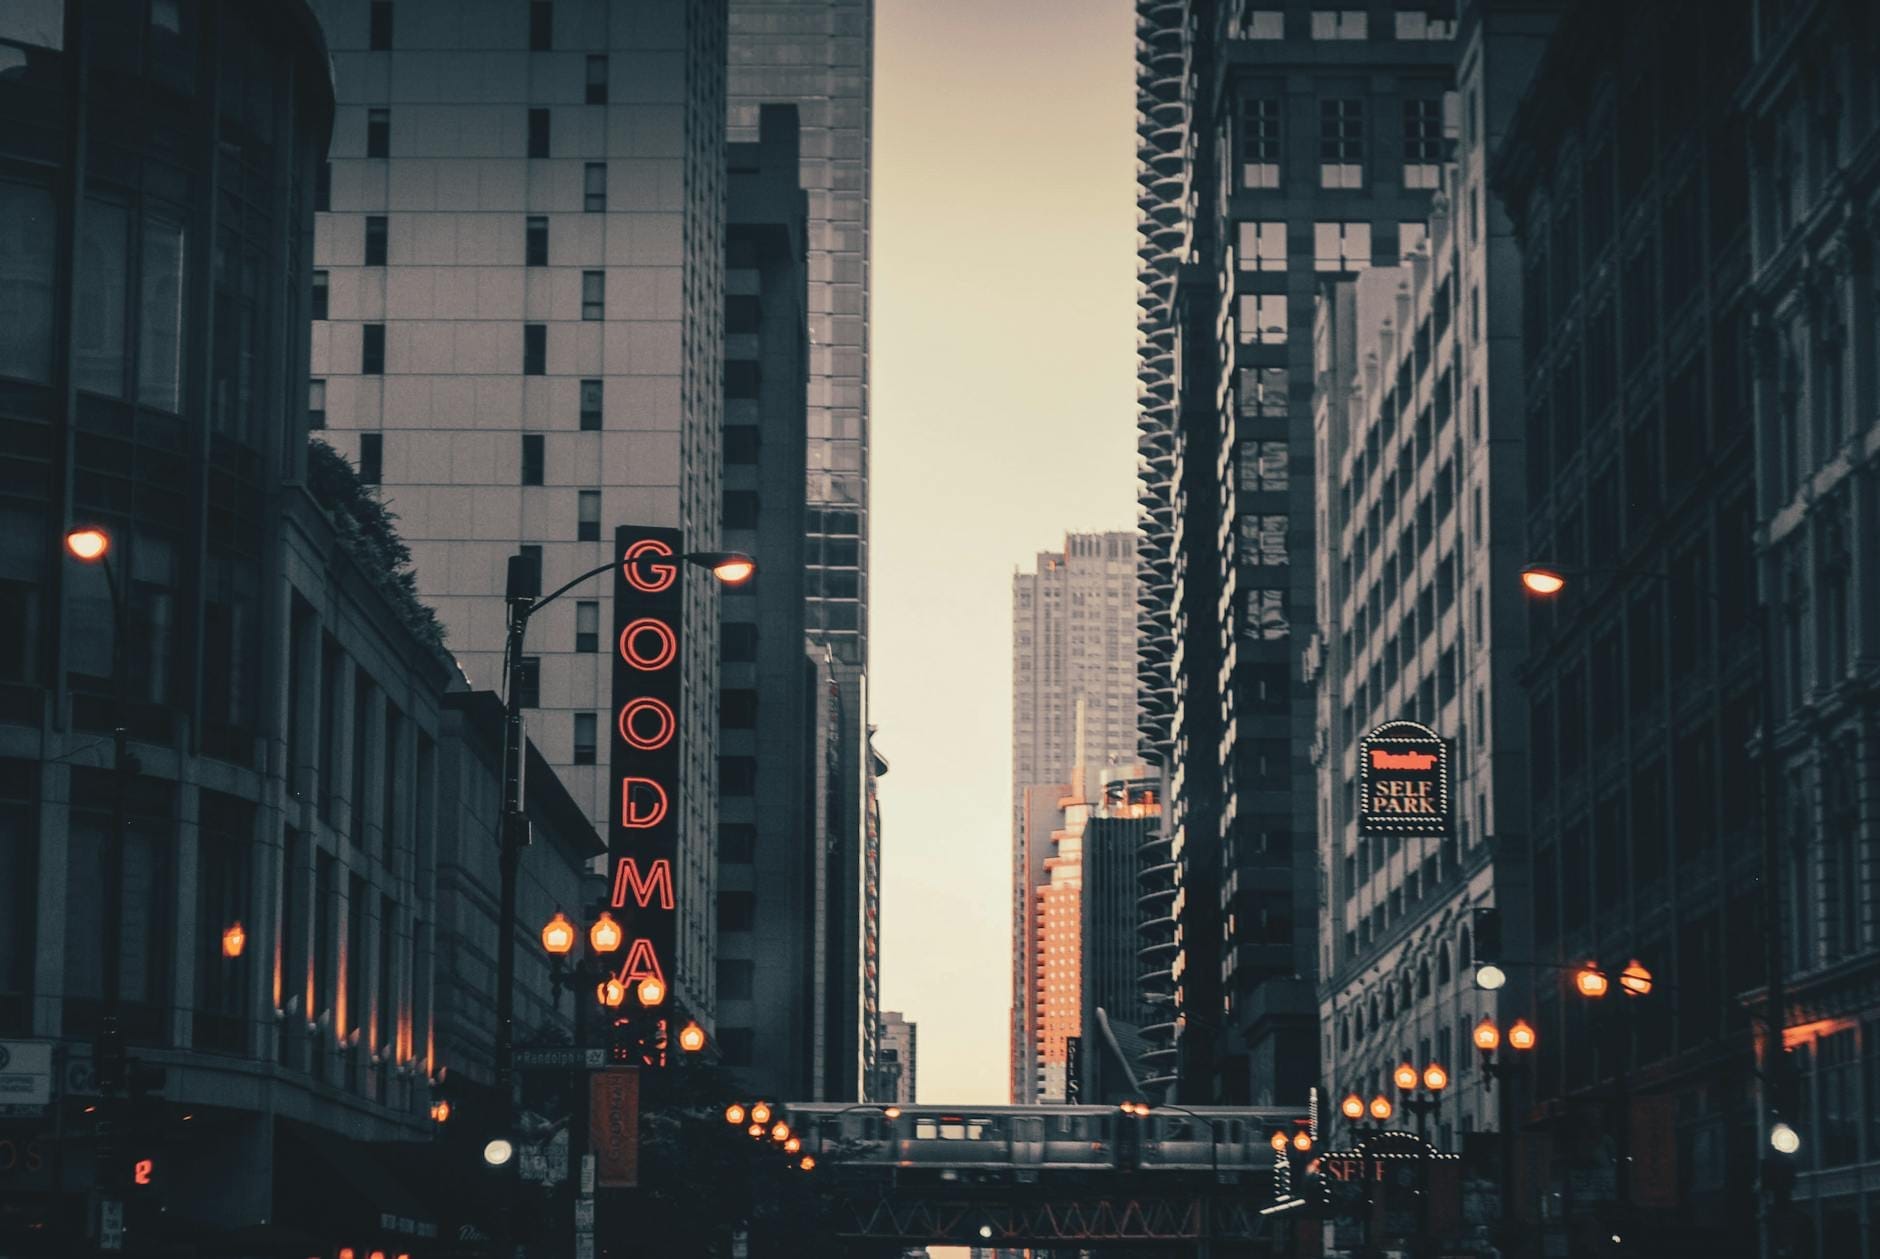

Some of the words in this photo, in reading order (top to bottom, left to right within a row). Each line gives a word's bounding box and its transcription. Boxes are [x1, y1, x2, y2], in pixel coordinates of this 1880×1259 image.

[1374, 780, 1433, 797] SELF
[610, 538, 678, 1067] GOODMA
[1372, 796, 1437, 814] PARK
[523, 1051, 575, 1067] Randolph
